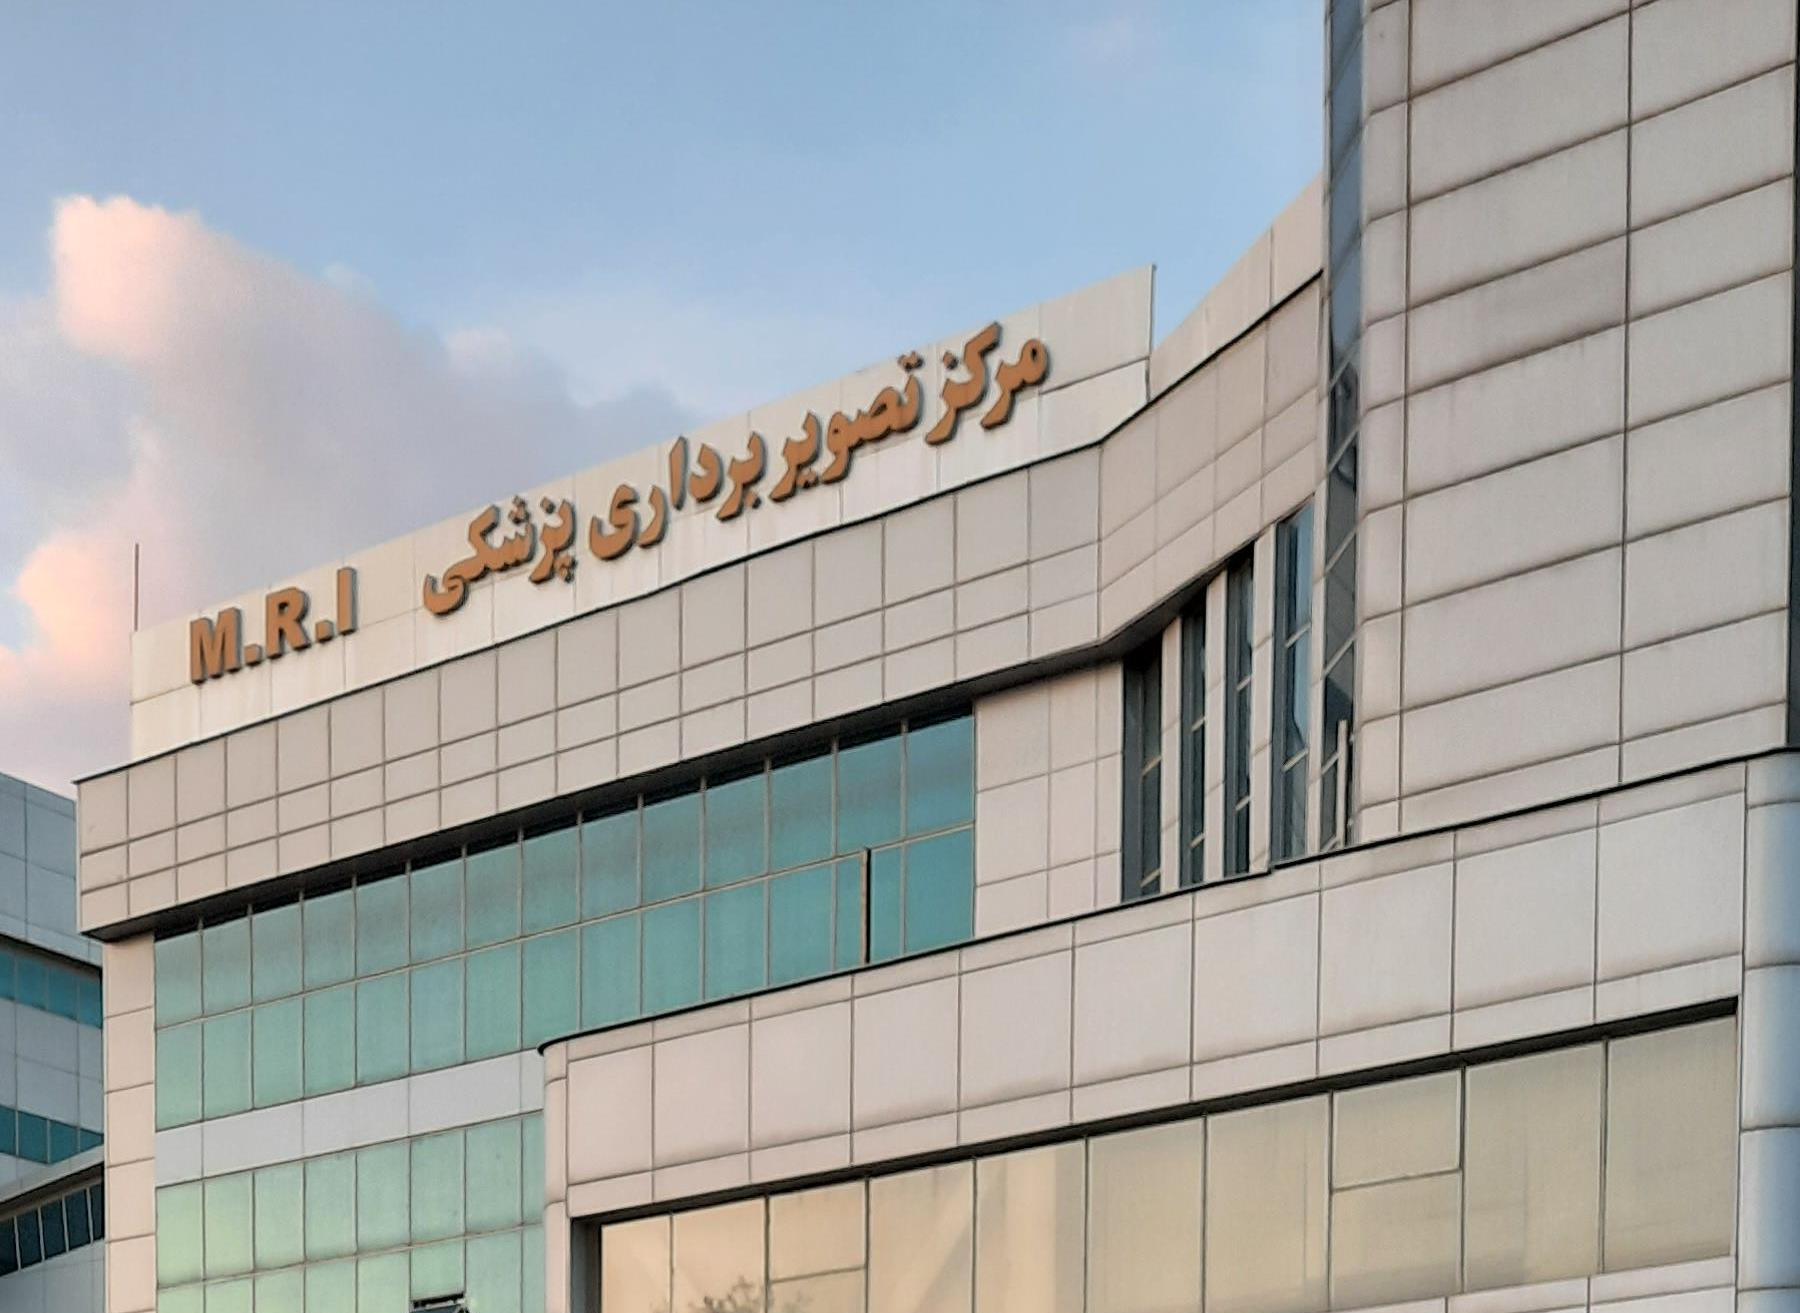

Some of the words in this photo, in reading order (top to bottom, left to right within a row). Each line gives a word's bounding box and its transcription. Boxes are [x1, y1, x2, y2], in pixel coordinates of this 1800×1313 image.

[925, 321, 1048, 446] مرکز
[422, 493, 578, 617] پزشکی
[189, 566, 358, 687] M.R.I
